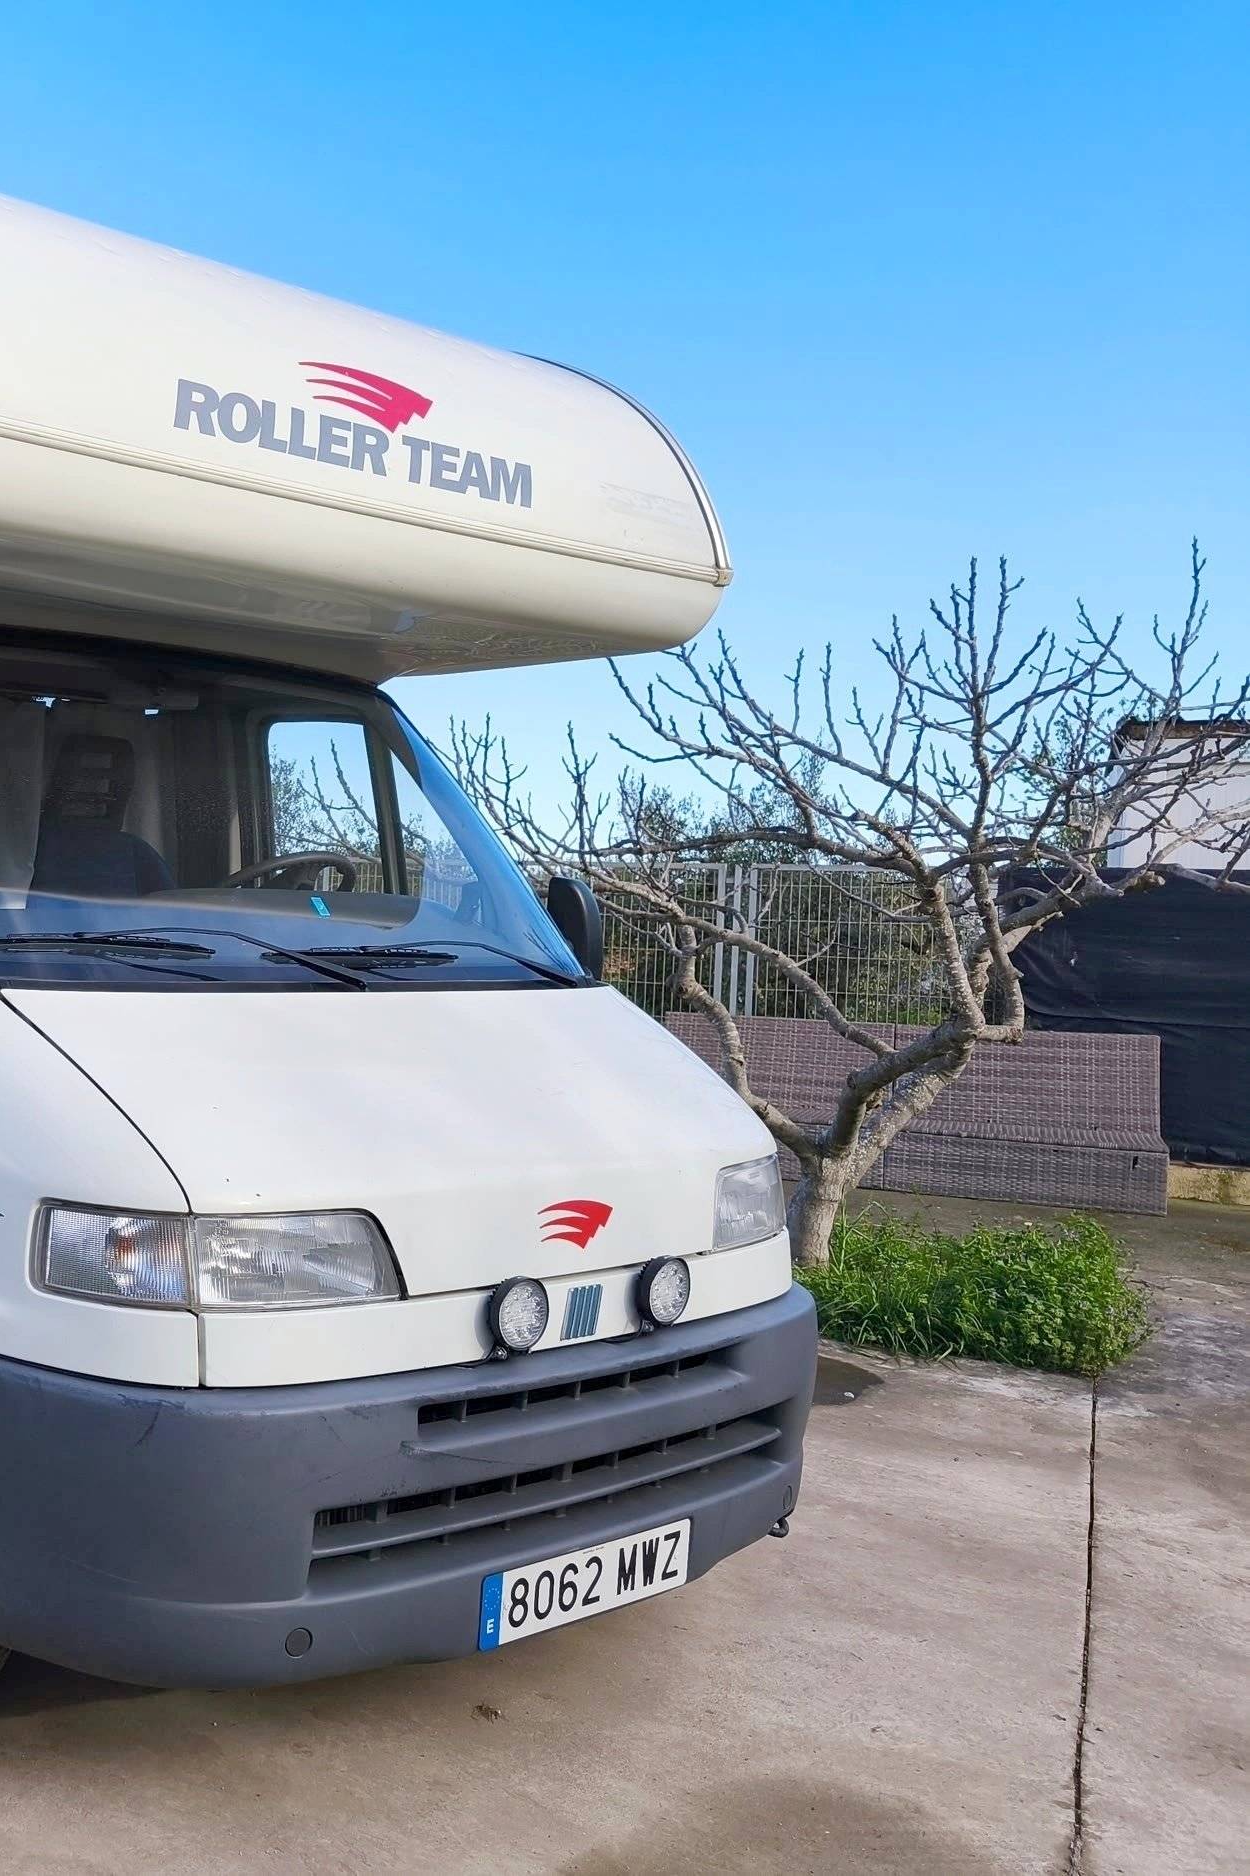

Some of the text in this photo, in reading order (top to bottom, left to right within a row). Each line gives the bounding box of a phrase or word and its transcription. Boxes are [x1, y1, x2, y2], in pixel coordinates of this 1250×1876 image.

[174, 378, 533, 508] ROLLER TEAM
[486, 1619, 494, 1634] E
[508, 1530, 681, 1628] 8062 MWZ
